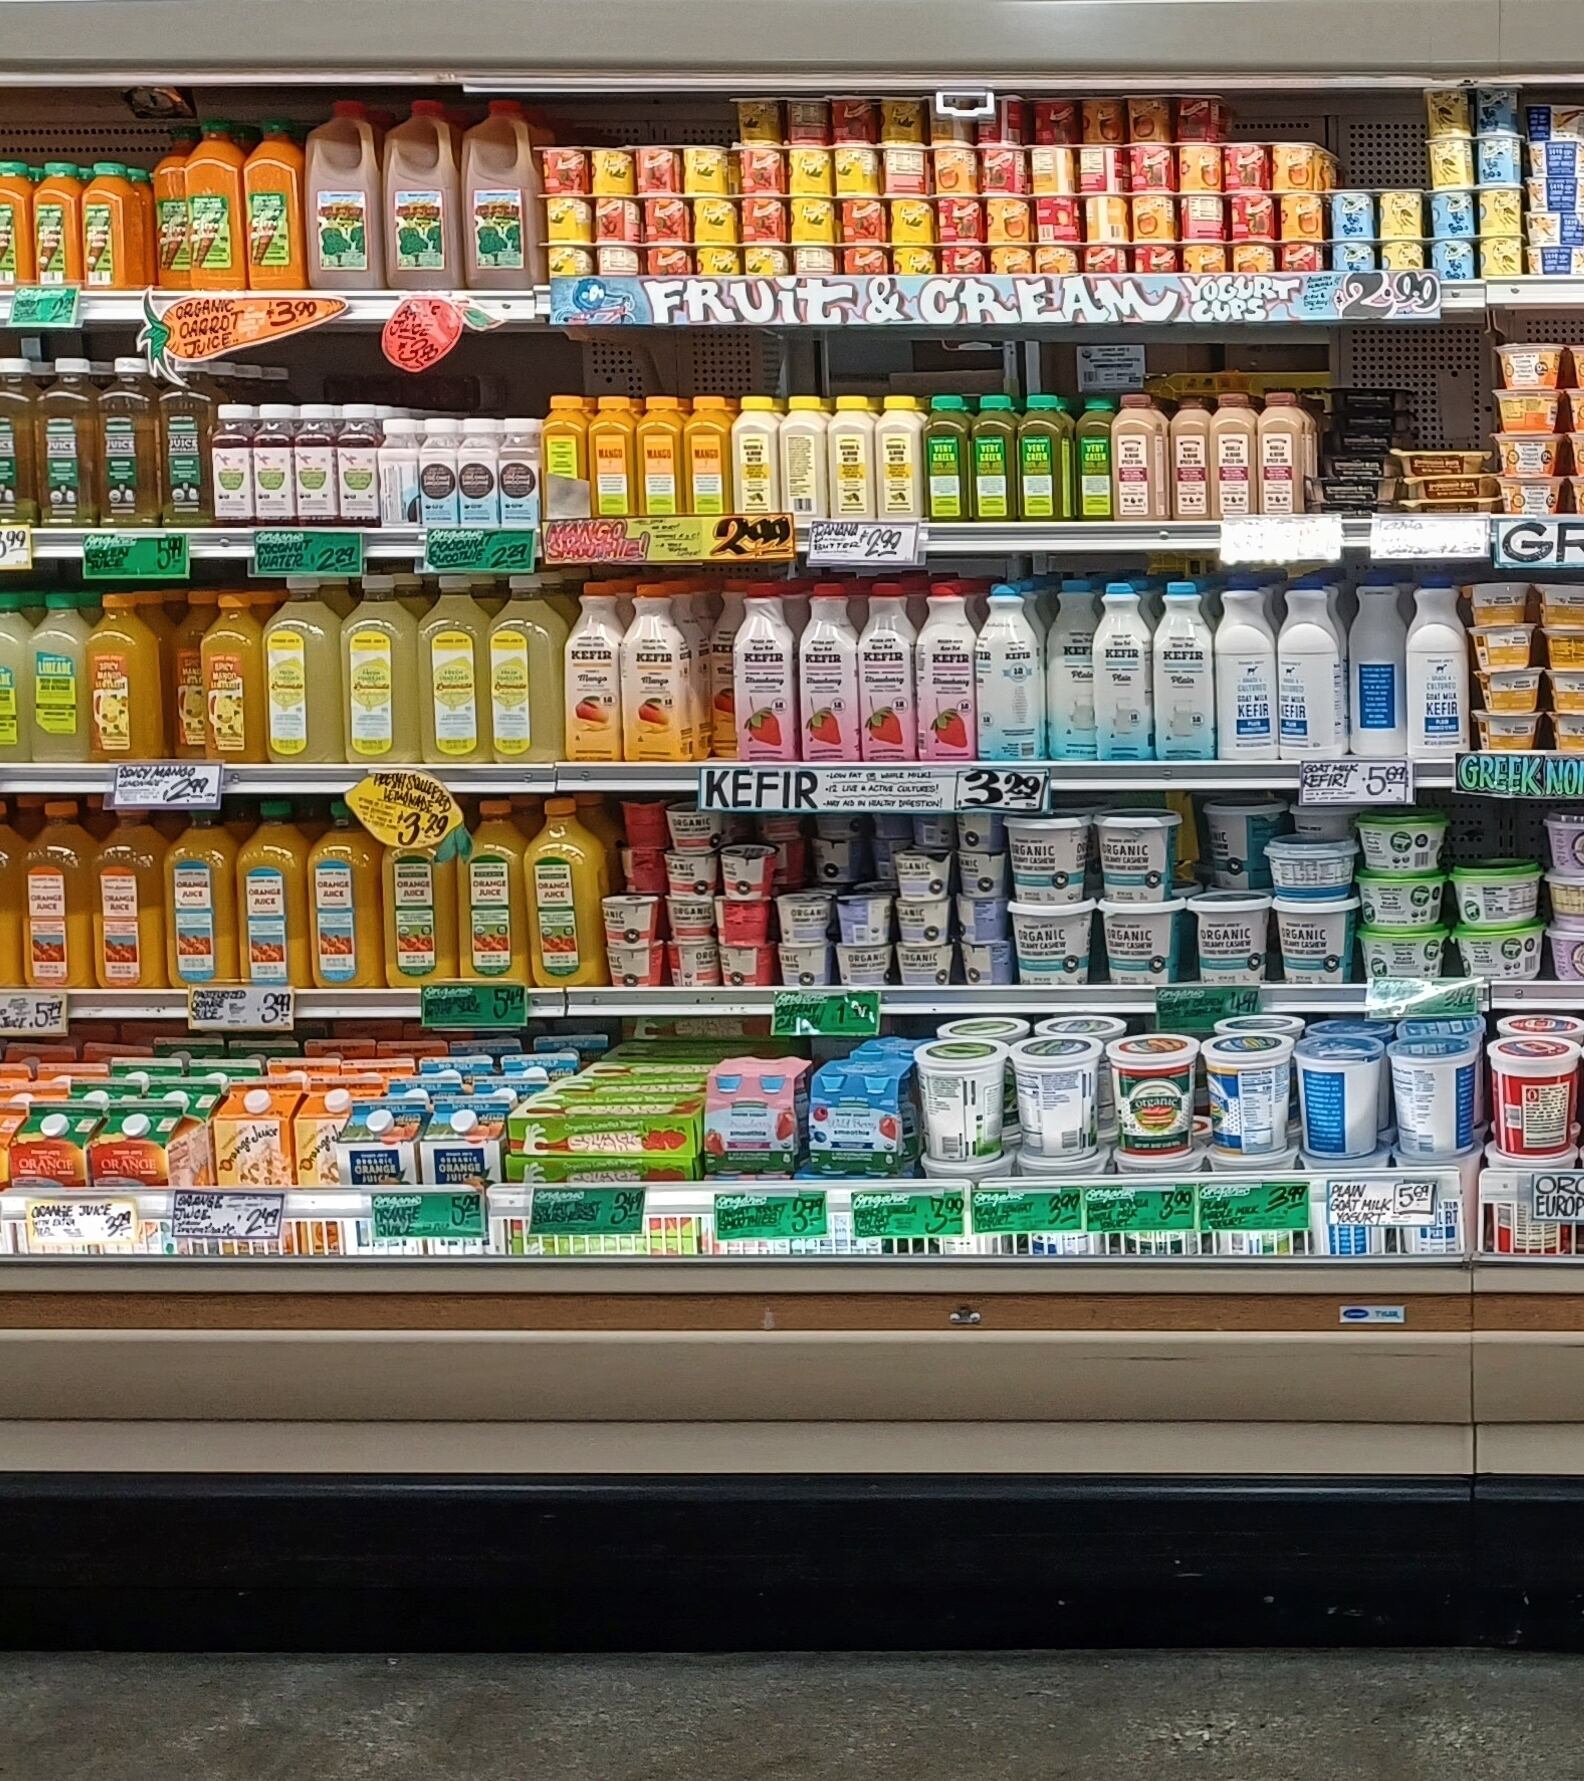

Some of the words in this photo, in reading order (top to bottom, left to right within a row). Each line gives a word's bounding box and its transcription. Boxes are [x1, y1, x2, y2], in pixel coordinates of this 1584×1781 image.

[1181, 274, 1302, 302] YOGURT
[866, 275, 916, 324] &
[921, 275, 1182, 325] CREAM
[1182, 299, 1274, 323] CUPS
[598, 448, 623, 459] MANGO
[646, 448, 672, 460] MANGO
[570, 650, 613, 661] KEFIR
[636, 652, 673, 664] KEFIR
[743, 652, 784, 663] KEFIR
[805, 654, 842, 664] KEFIR
[863, 651, 904, 662] KEFIR
[931, 653, 970, 664] KEFIR
[1457, 754, 1544, 798] GREEK
[704, 769, 819, 810] KEFIR
[175, 880, 209, 889] ORANGE
[316, 880, 350, 889] ORANGE
[182, 889, 204, 898] JUICE
[248, 888, 282, 897] ORANGE
[323, 889, 346, 898] JUICE
[403, 889, 425, 898] JUICE
[30, 894, 63, 902] ORANGE
[103, 894, 135, 903] ORANGE
[254, 896, 276, 906] JUICE
[36, 901, 58, 910] JUICE
[110, 902, 130, 911] JUICE
